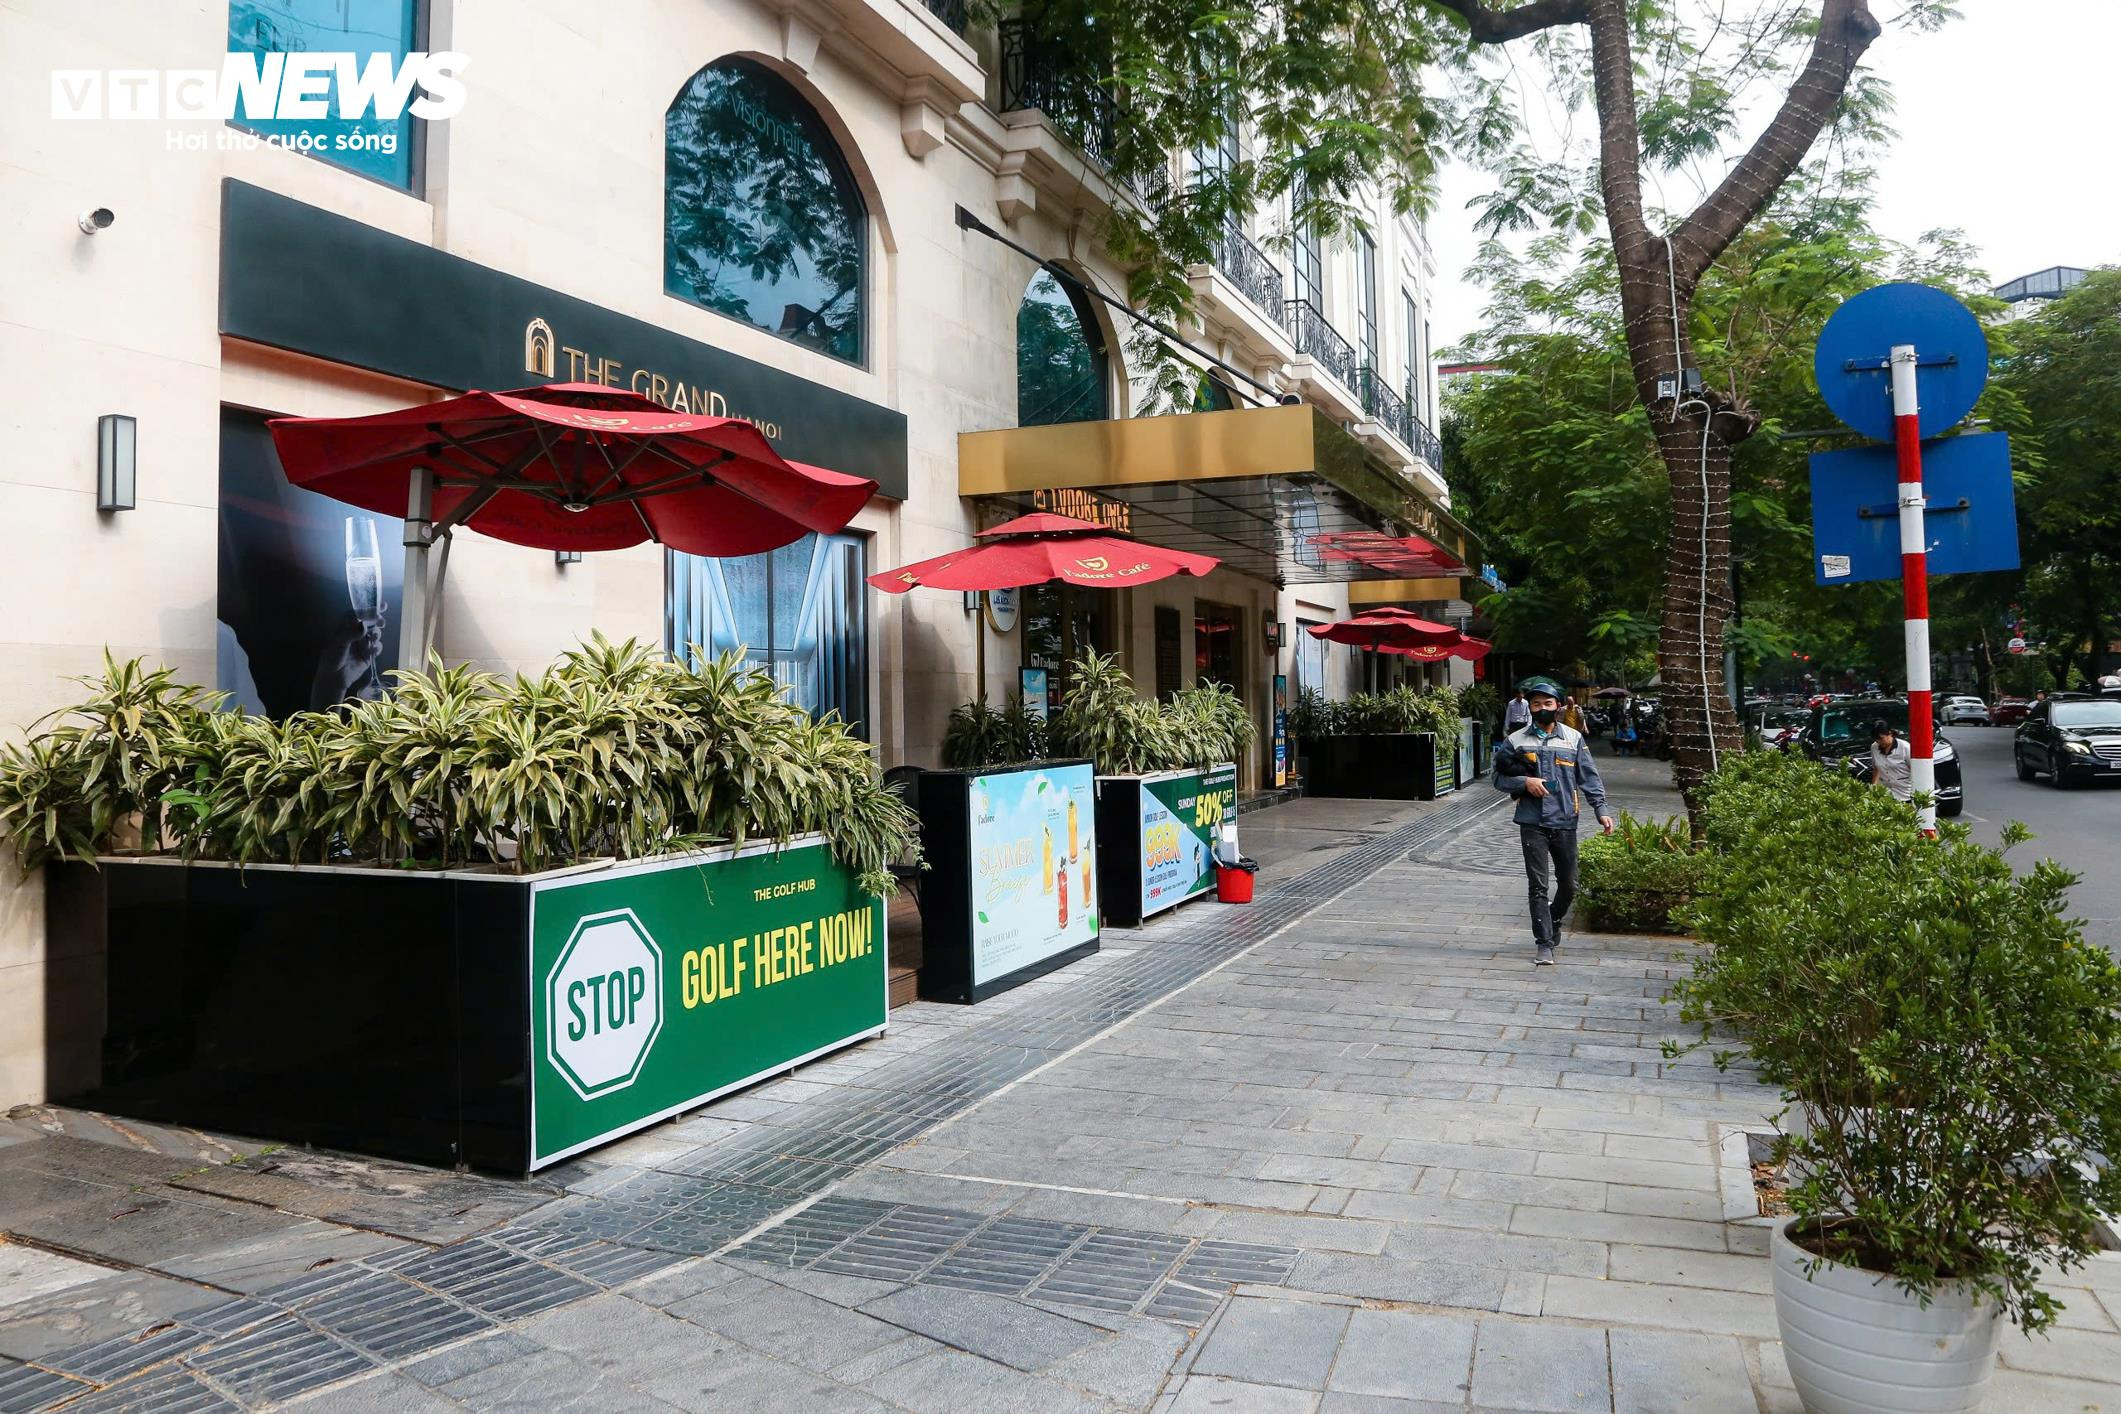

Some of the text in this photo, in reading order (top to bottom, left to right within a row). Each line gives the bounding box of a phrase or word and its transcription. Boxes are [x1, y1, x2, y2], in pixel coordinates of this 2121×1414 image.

[562, 346, 622, 386] THE
[632, 369, 727, 418] GRAND
[1118, 563, 1151, 576] Café
[1178, 797, 1196, 810] SUNDAY
[1195, 791, 1223, 827] 50%
[1222, 789, 1233, 803] OFF
[754, 878, 816, 902] THE GOLF HUB
[681, 906, 873, 1009] GOLF HERE NOW!
[567, 966, 645, 1042] STOP
